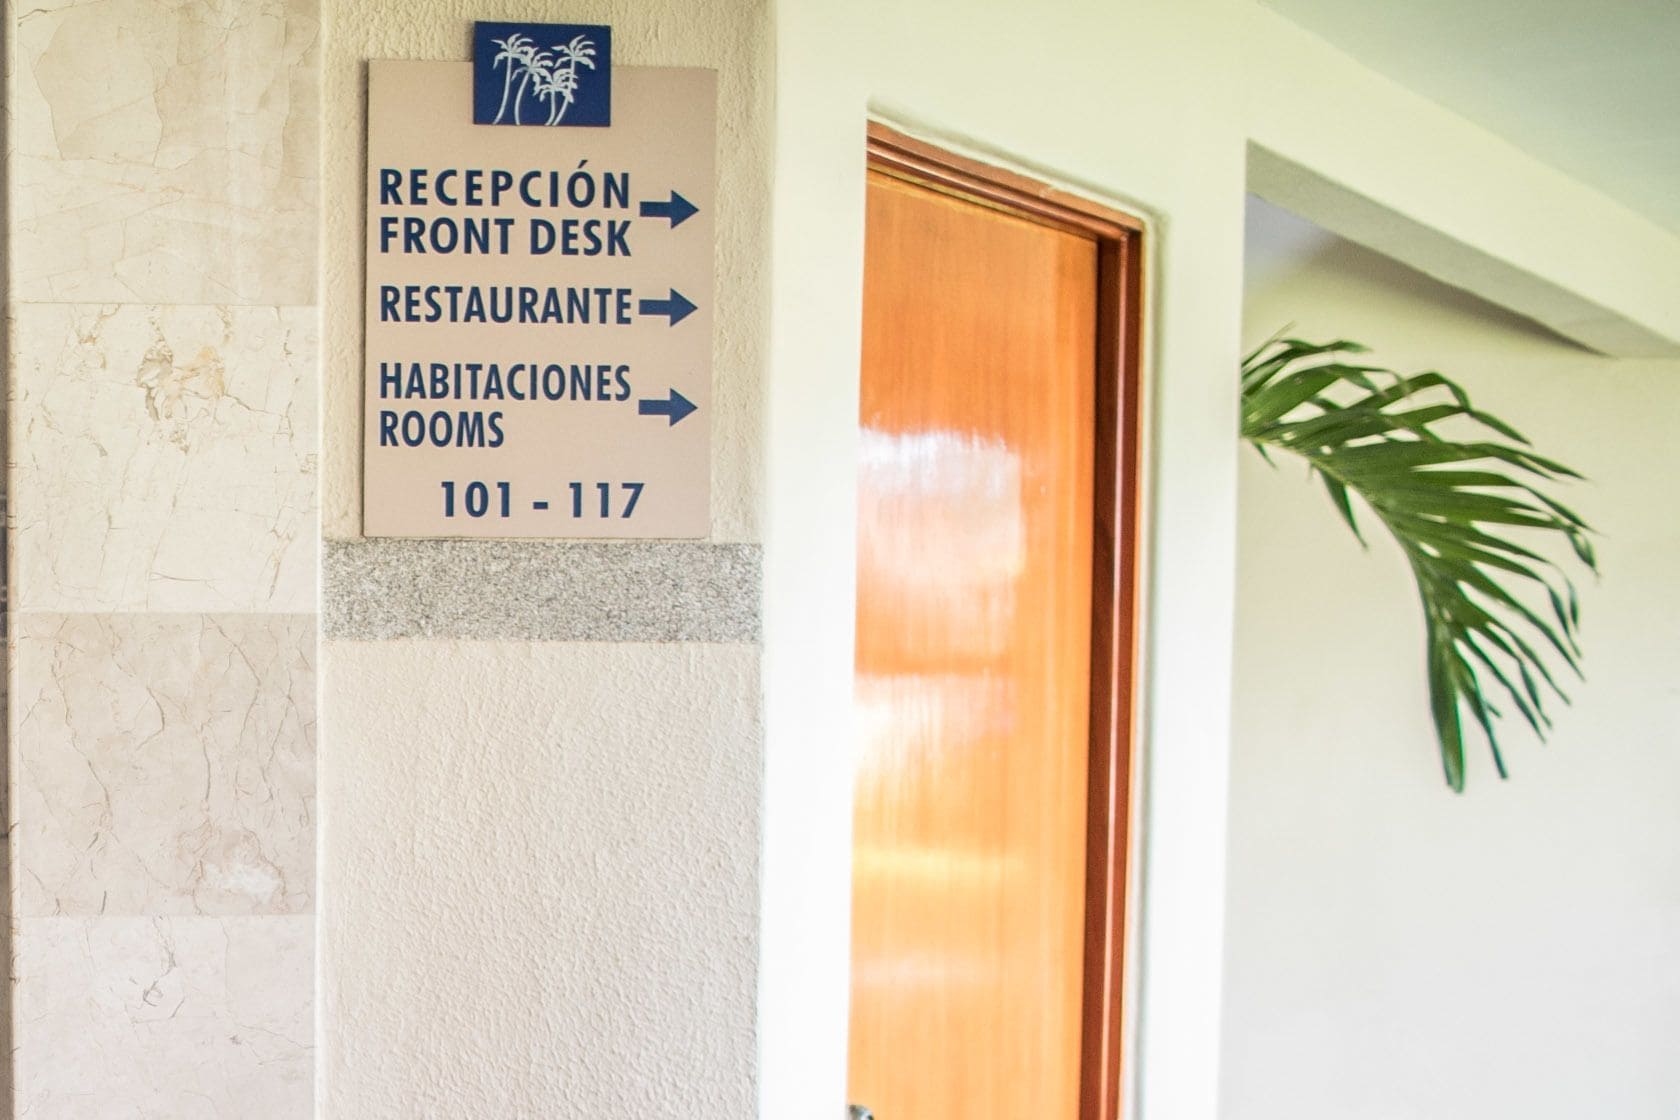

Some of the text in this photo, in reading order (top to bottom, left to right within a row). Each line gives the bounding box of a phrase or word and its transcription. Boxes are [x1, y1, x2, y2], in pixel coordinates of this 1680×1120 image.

[379, 159, 630, 209] RECEPCIÓN
[379, 217, 632, 257] FRONT DESK
[379, 285, 633, 325] RESTAURANTE
[379, 362, 632, 402] HABITACIONES
[379, 410, 505, 448] ROOMS
[441, 480, 511, 518] 101
[569, 482, 645, 519] 117
